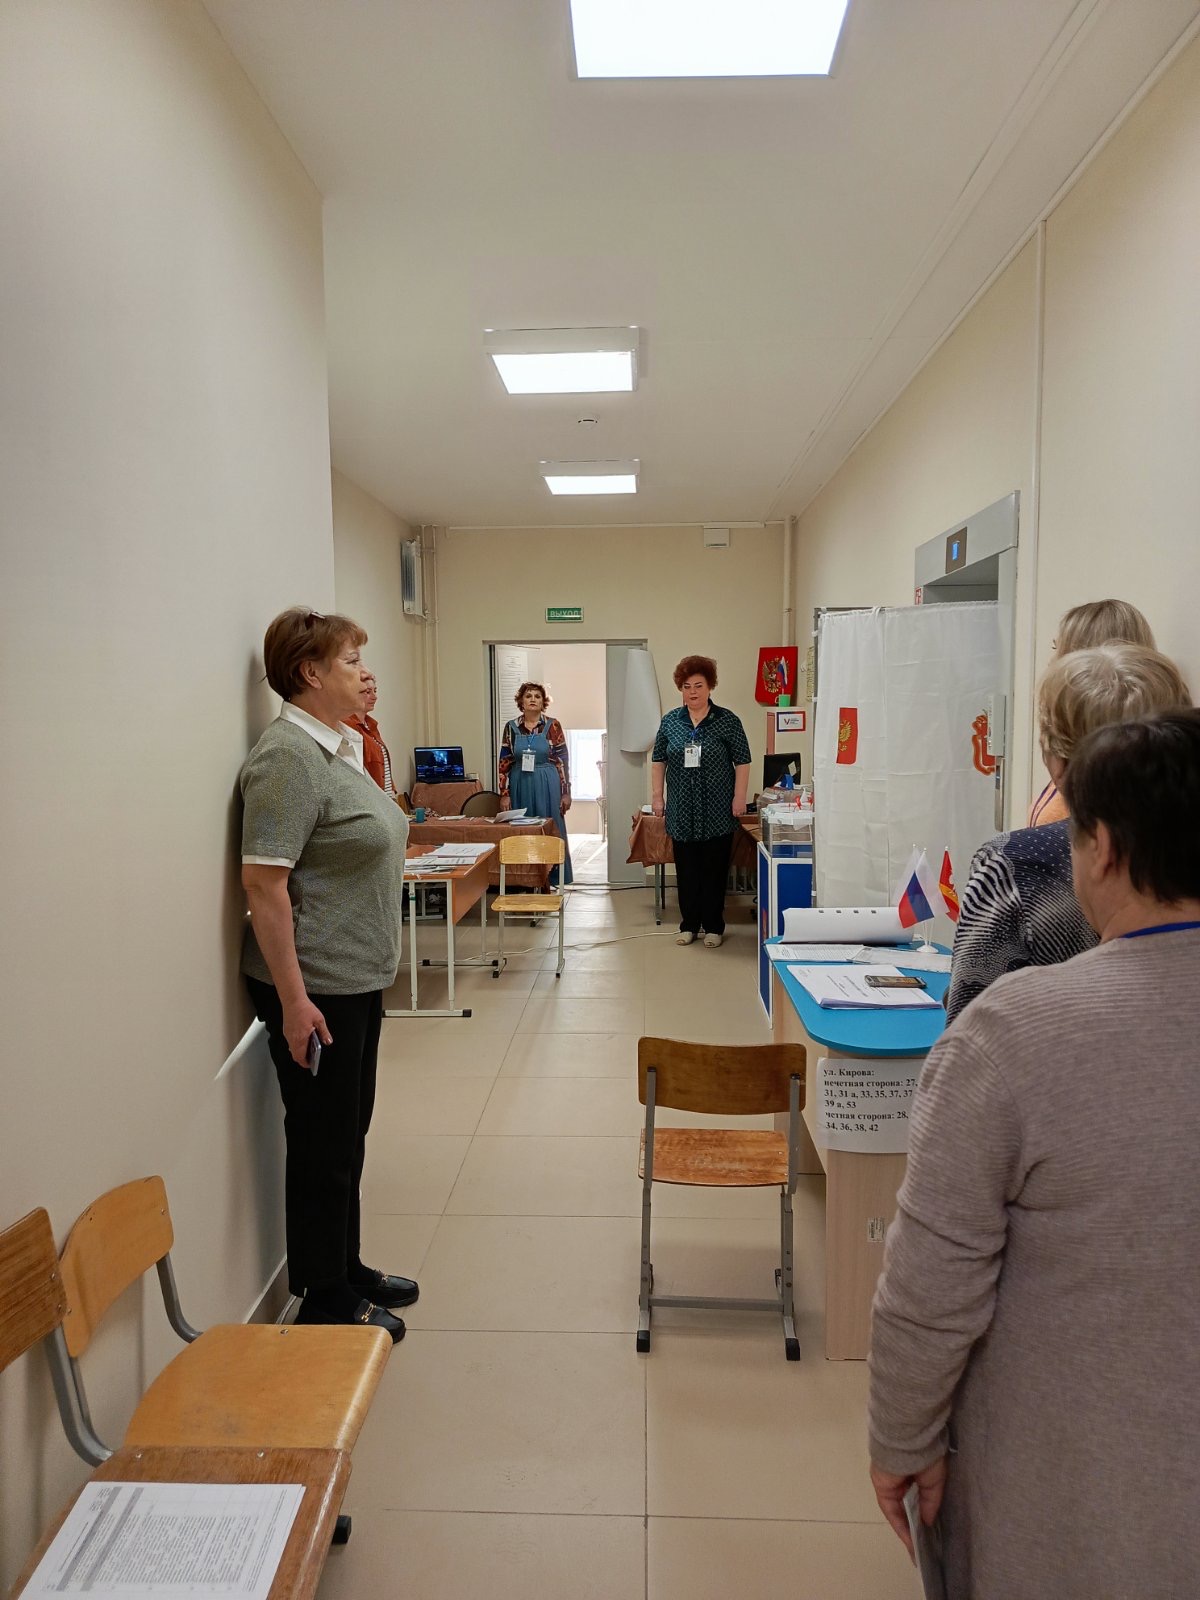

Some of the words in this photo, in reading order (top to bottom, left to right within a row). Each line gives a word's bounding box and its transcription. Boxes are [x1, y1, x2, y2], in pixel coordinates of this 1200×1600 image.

[839, 1069, 875, 1078] Кирова:
[860, 1090, 873, 1098] 33,
[875, 1090, 887, 1098] 35,
[889, 1090, 901, 1098] 37,
[858, 1113, 894, 1121] сторона:
[826, 1122, 838, 1130] 34,
[840, 1123, 852, 1131] 36,
[854, 1124, 866, 1132] 38,
